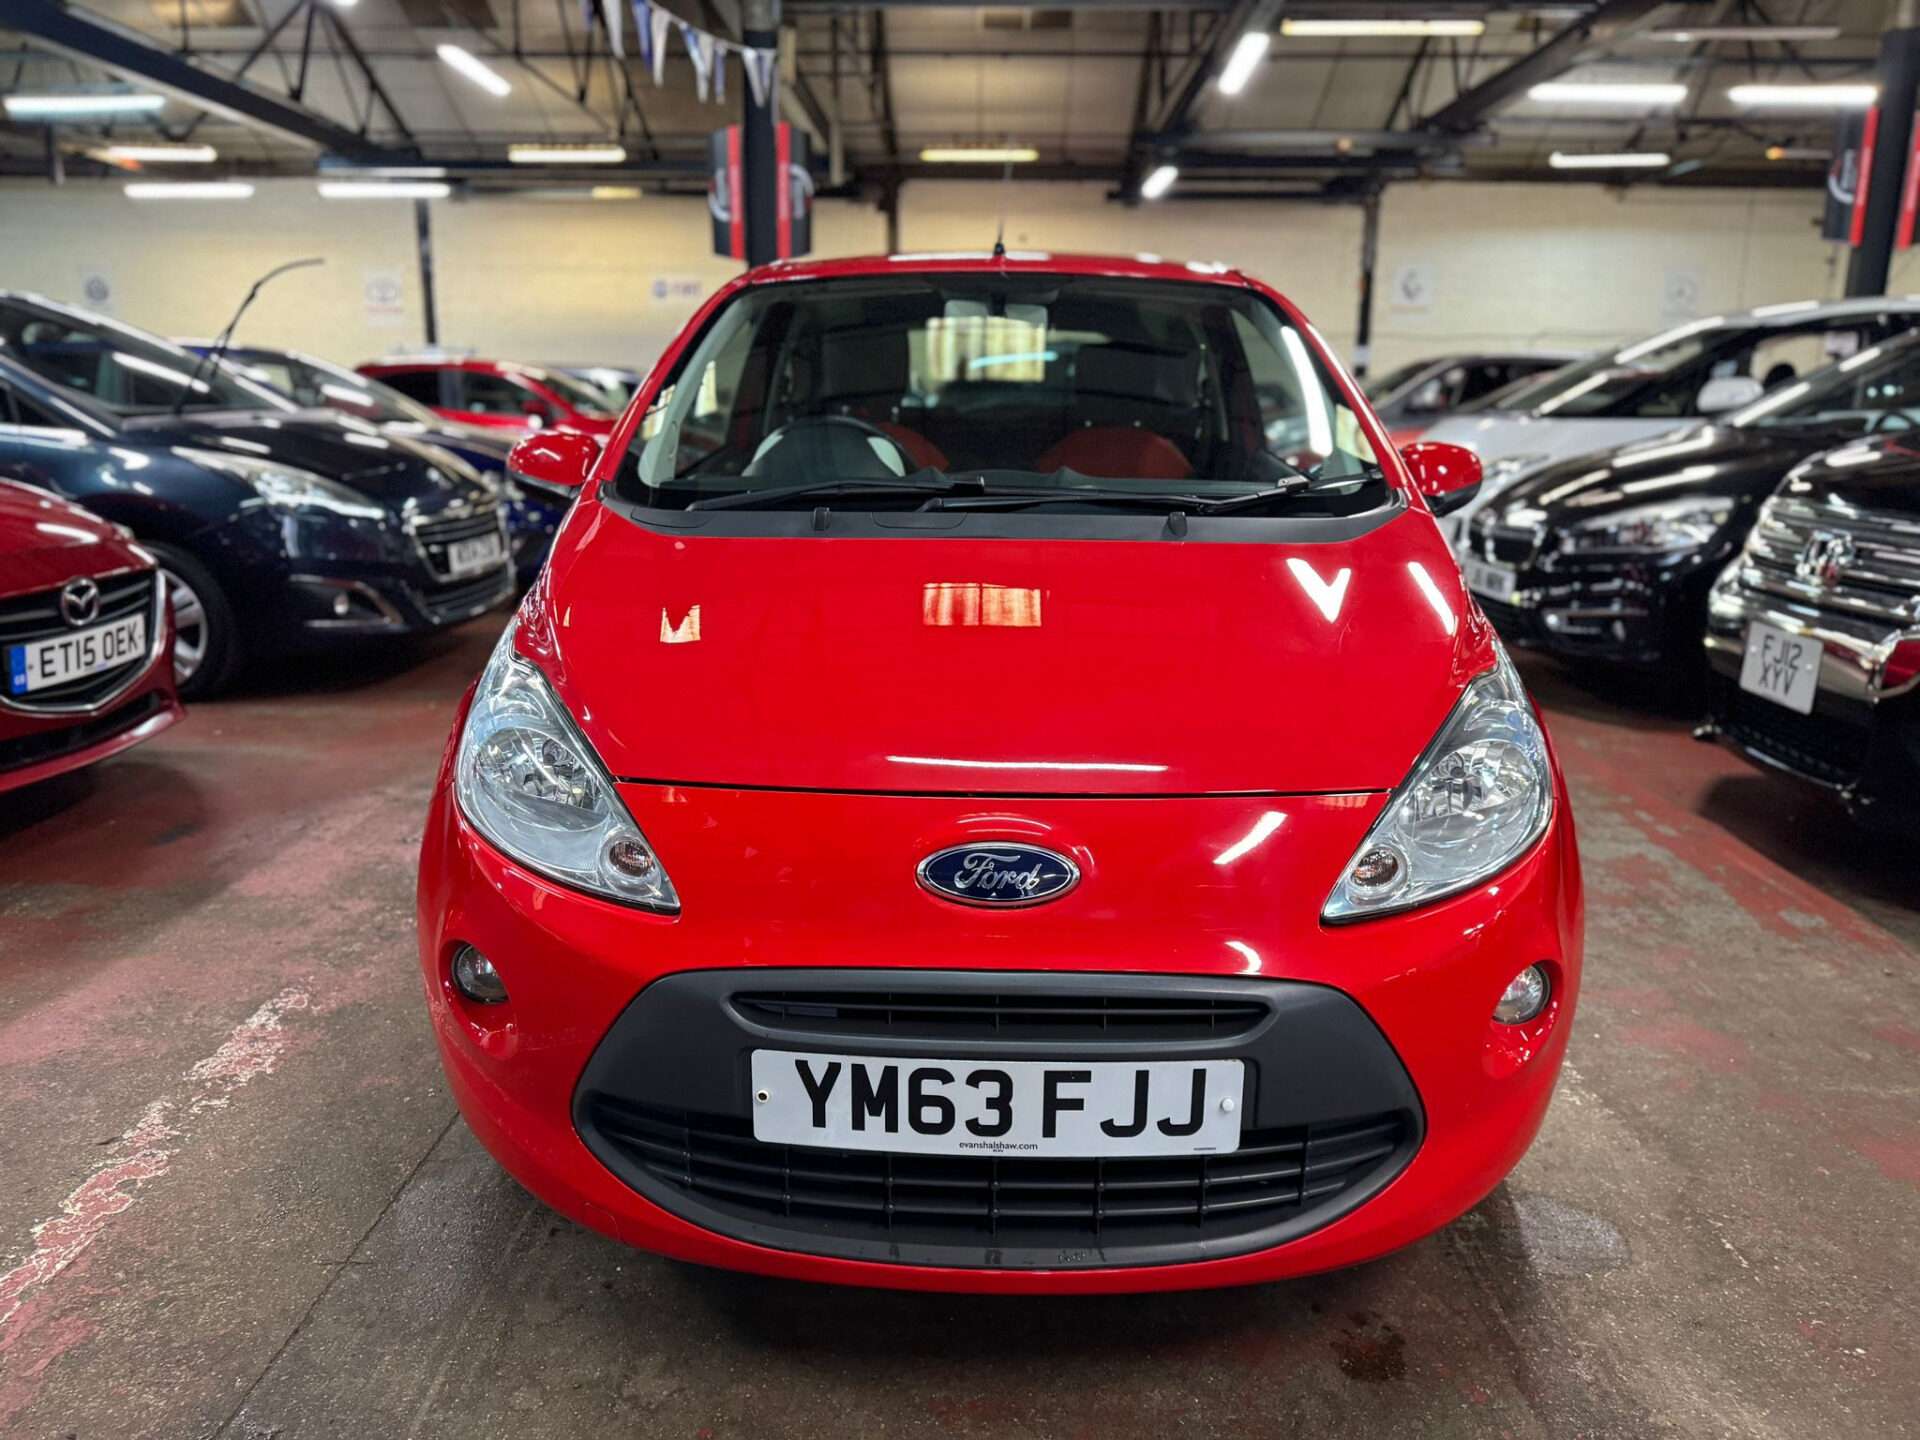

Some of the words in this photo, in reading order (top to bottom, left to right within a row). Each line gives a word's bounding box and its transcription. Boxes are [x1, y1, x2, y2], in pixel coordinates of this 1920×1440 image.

[40, 635, 96, 679] ET15
[103, 622, 138, 660] OEK
[1762, 634, 1803, 670] FJ12
[1758, 662, 1799, 696] XYV
[953, 852, 1042, 890] Ford
[794, 1059, 1014, 1137] YM63
[1042, 1068, 1207, 1138] FJJ
[959, 1141, 1038, 1151] evanshalshaw.com
